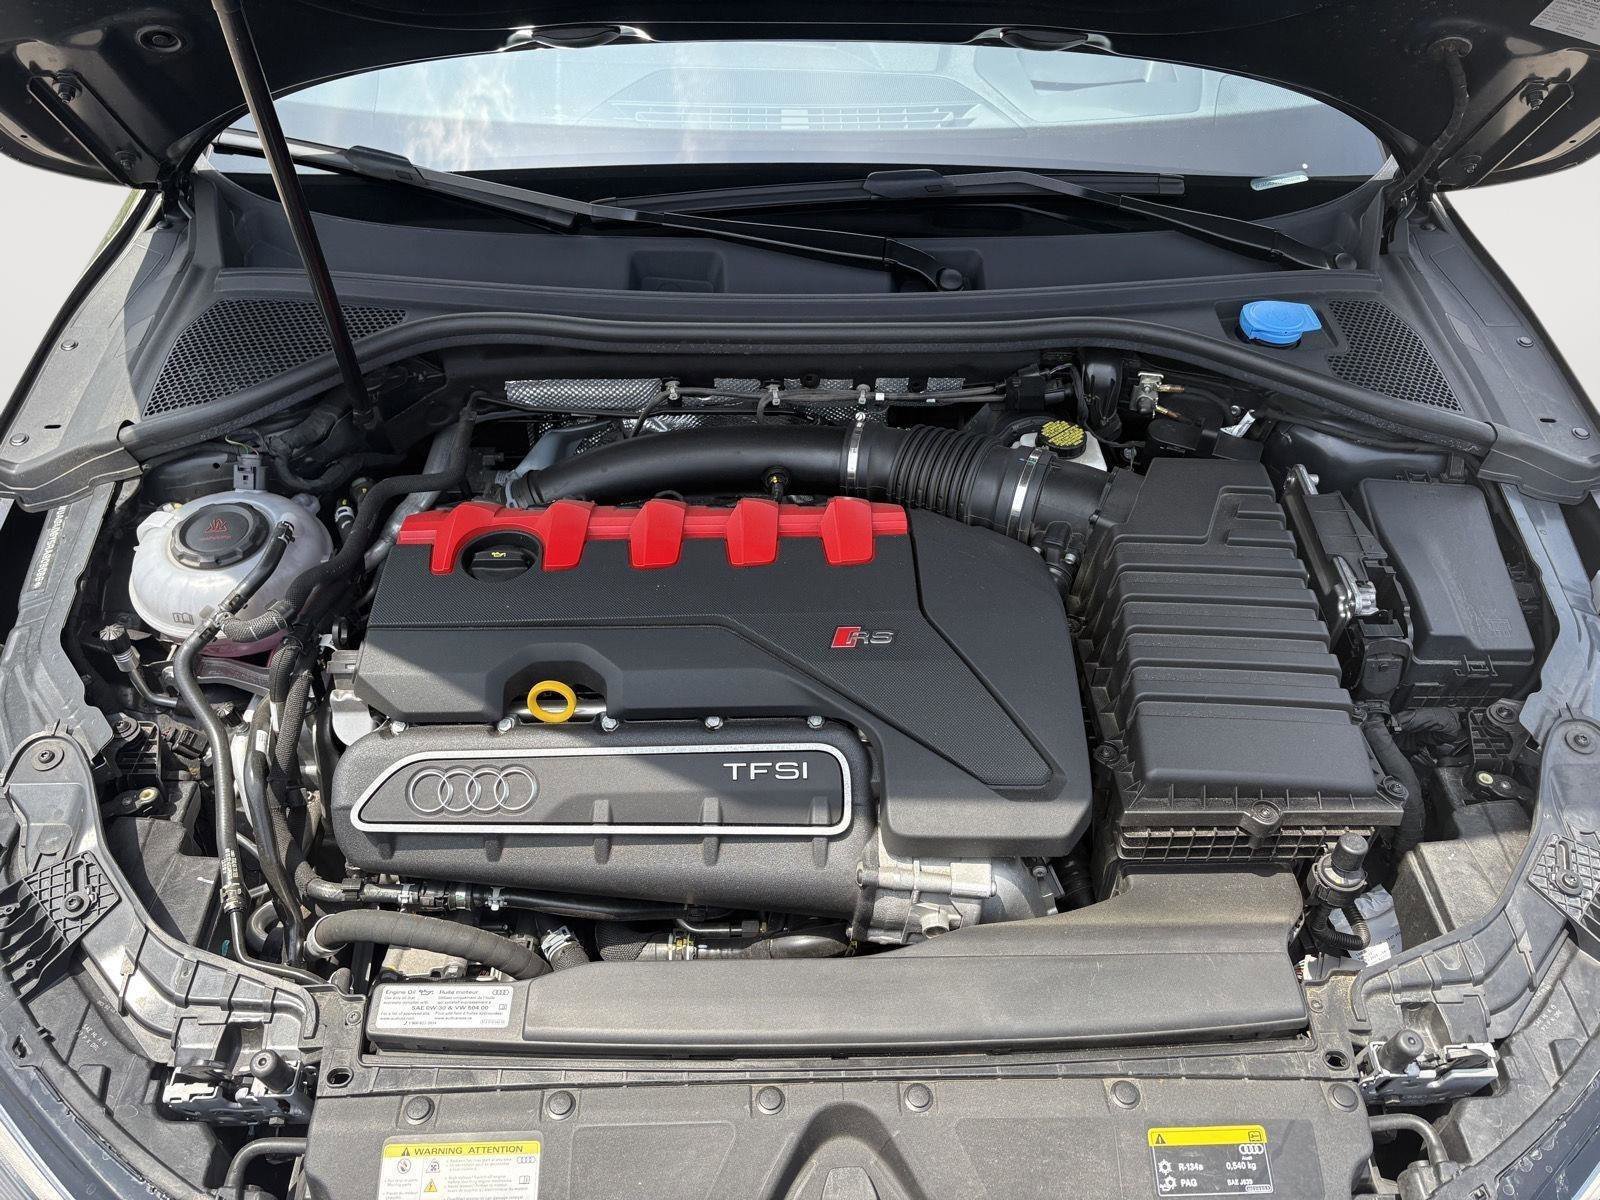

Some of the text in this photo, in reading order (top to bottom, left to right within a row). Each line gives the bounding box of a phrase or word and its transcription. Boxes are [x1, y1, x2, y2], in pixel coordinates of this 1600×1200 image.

[722, 761, 808, 781] TFSI
[414, 1145, 523, 1155] WARNING ATTENTION
[1178, 1162, 1204, 1171] R-134a
[1225, 1160, 1257, 1171] 0,540 kg
[1180, 1178, 1198, 1187] PAG
